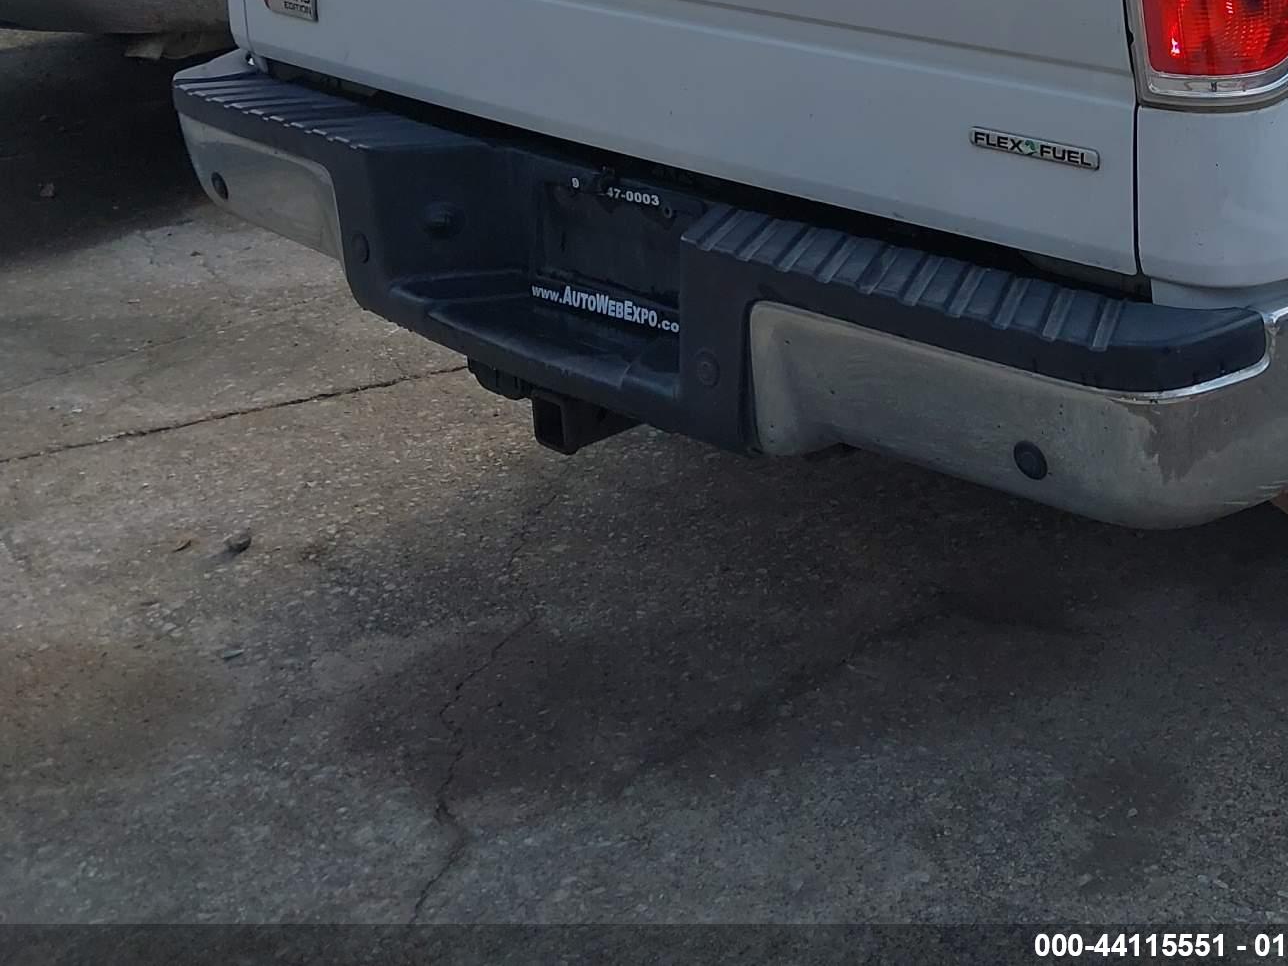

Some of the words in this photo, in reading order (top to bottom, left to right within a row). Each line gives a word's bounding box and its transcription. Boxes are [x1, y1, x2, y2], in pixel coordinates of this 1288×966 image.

[283, 1, 314, 18] EDITION
[974, 131, 1023, 153] FLEX
[1039, 144, 1092, 167] FUEL
